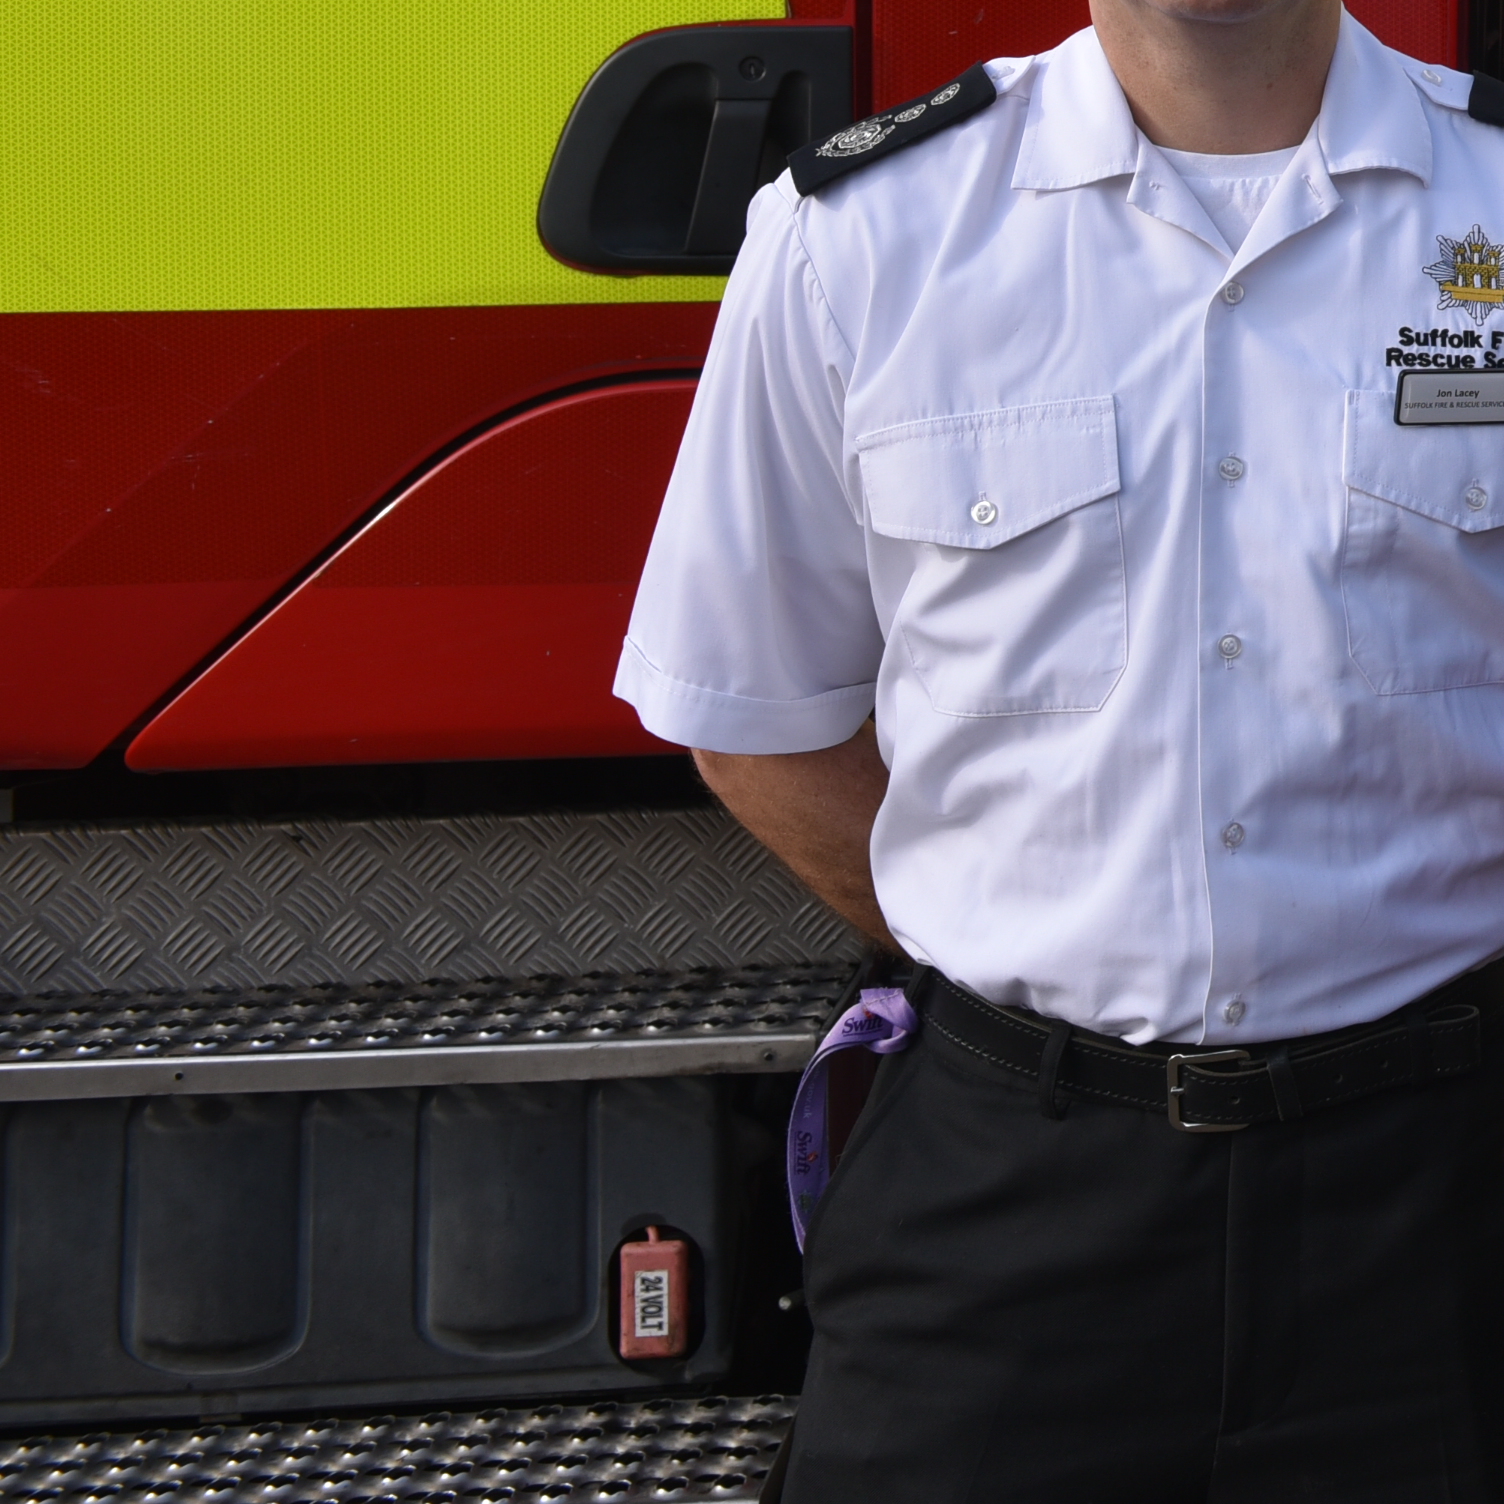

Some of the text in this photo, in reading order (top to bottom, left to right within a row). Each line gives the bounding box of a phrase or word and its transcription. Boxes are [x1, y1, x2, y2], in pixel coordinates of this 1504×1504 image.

[1398, 326, 1484, 349] Suffolk
[1385, 347, 1475, 369] Rescue
[1436, 389, 1480, 399] Jon Lacey
[797, 1131, 813, 1175] Swift
[639, 1276, 664, 1331] 24 VOLT
